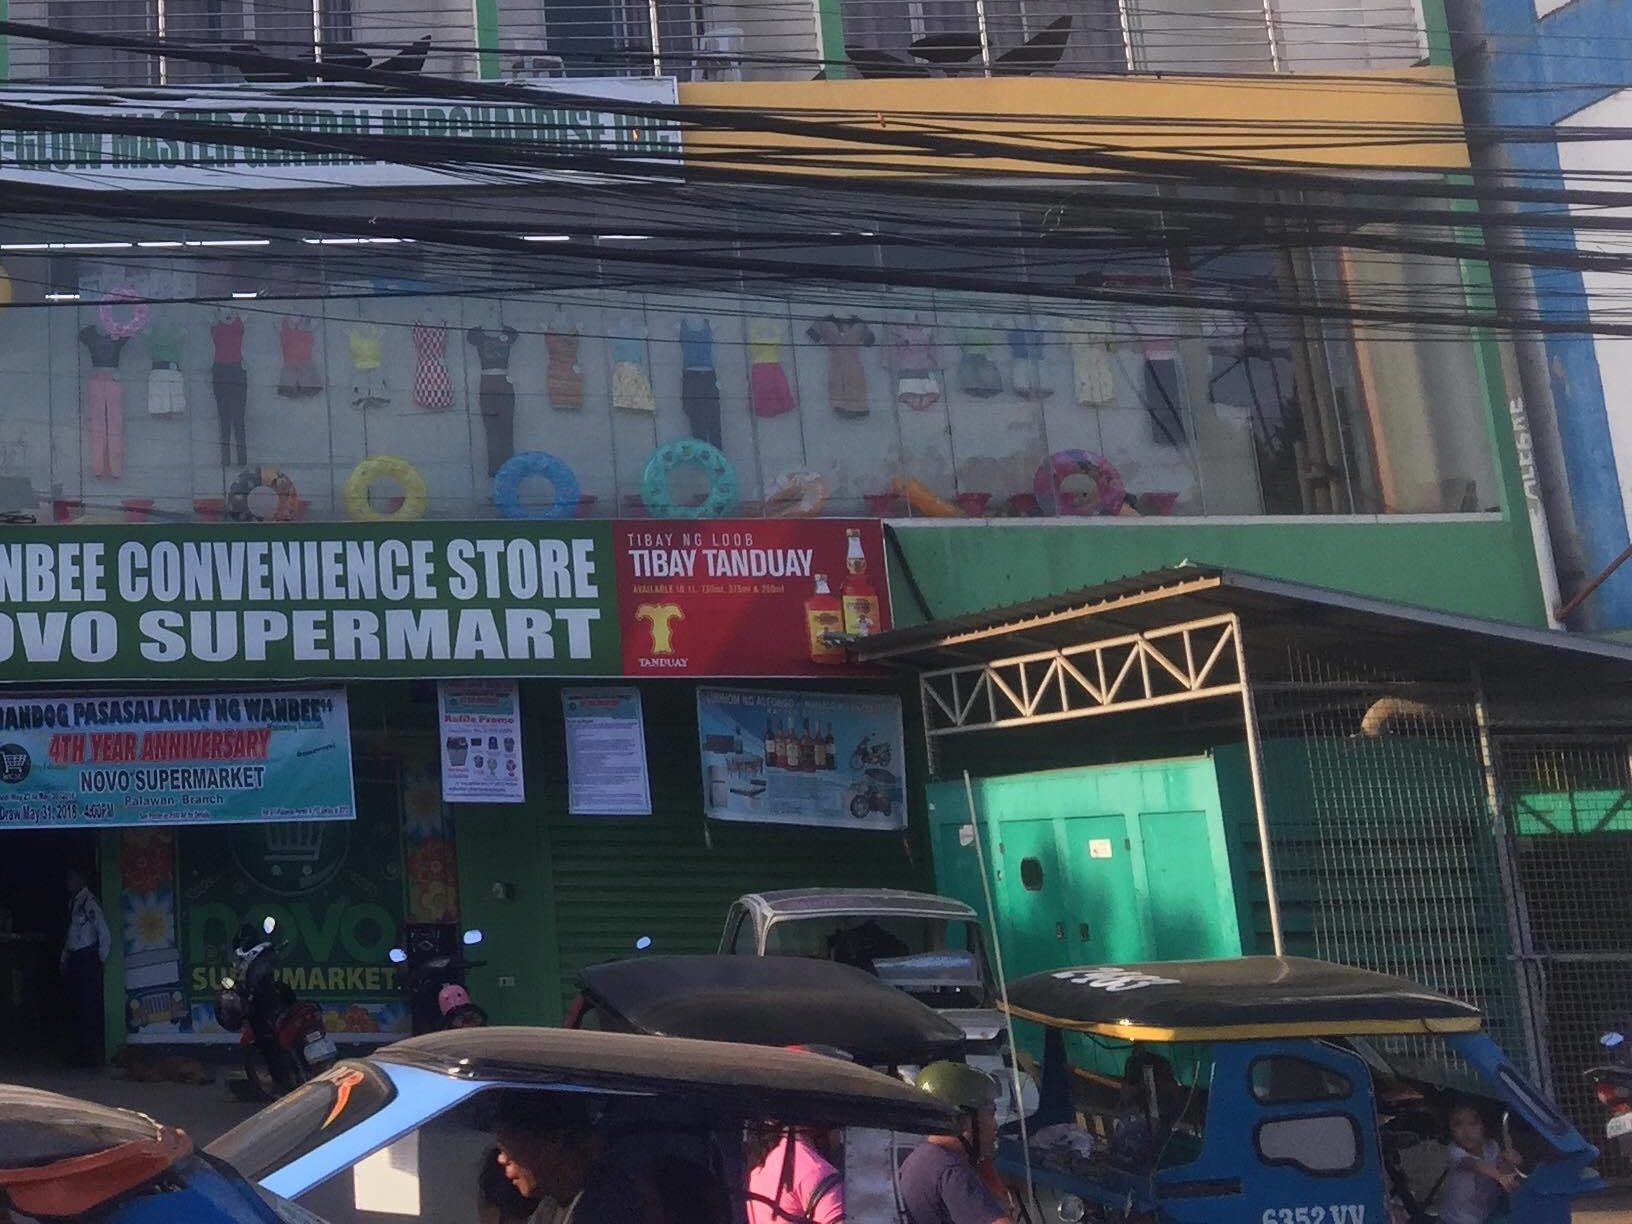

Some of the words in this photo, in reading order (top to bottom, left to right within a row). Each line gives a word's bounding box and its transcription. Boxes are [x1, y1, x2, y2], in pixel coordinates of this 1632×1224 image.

[627, 533, 673, 547] TIBAY
[683, 533, 703, 547] NG
[712, 533, 754, 547] LOOB
[118, 539, 435, 602] CONVENIENCE
[446, 538, 600, 601] STORE
[628, 549, 697, 577] TIBAY
[702, 548, 814, 577] TANDUAY
[138, 608, 601, 663] SUPERMART
[638, 657, 689, 668] TANDUAY
[73, 698, 212, 727] PASASALAMAT
[215, 697, 242, 722] NG
[48, 732, 86, 764] 4TH
[89, 731, 138, 763] YEAR
[141, 728, 272, 762] ANNIVERSARY
[79, 770, 132, 794] NOVO
[135, 766, 265, 792] SUPERMARKET
[182, 794, 225, 806] Branch
[0, 805, 21, 821] Draw
[22, 805, 40, 824] May
